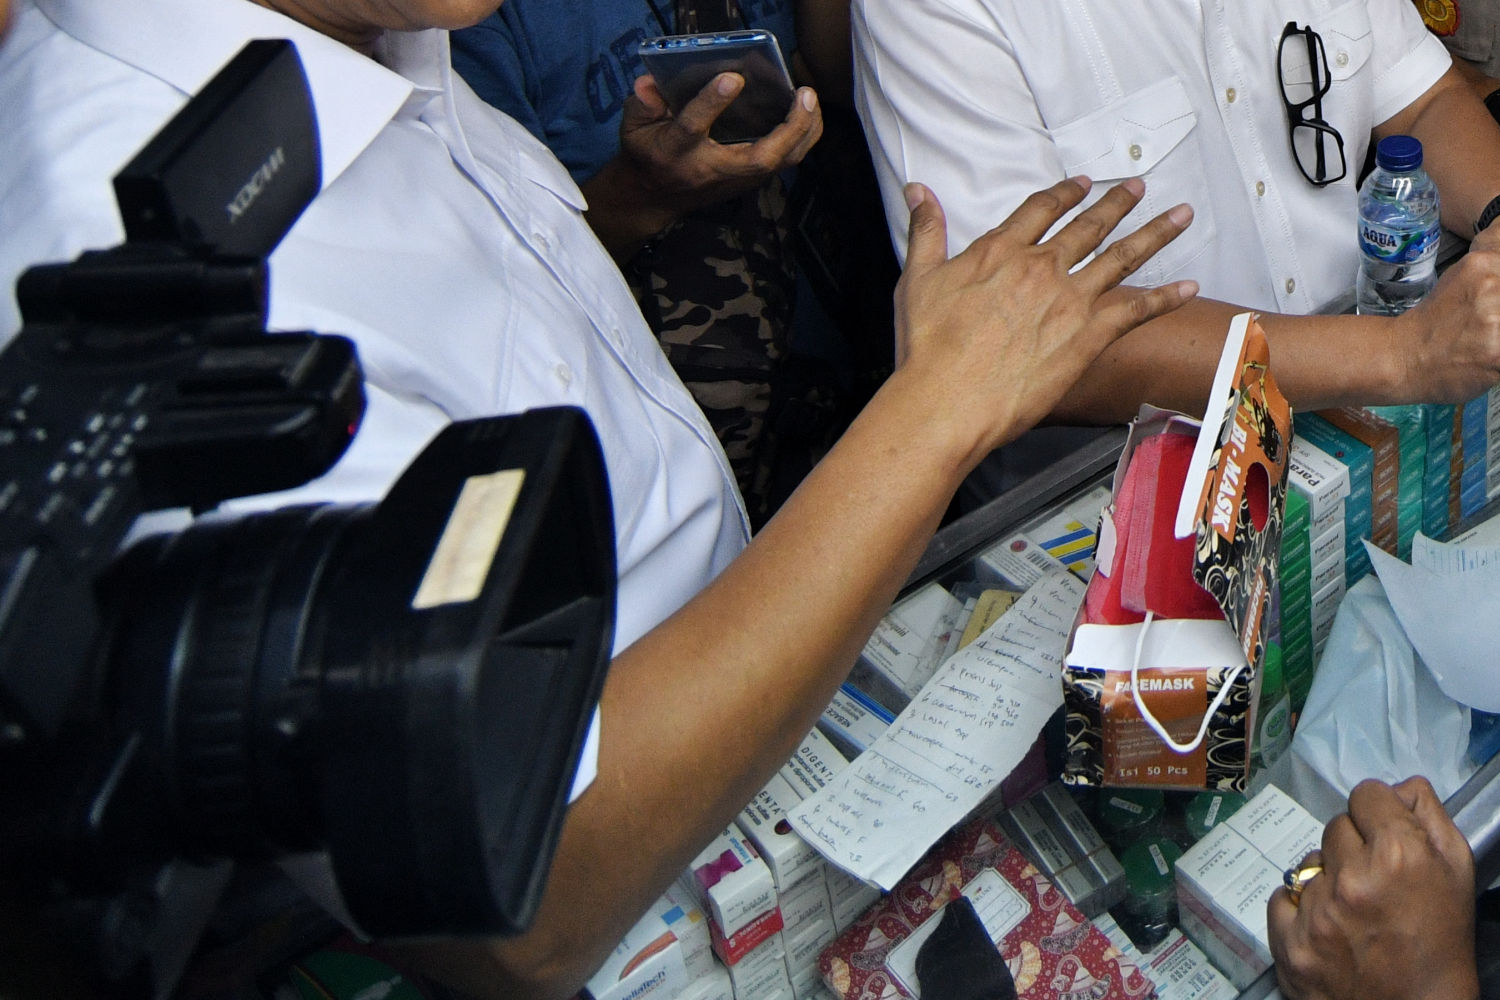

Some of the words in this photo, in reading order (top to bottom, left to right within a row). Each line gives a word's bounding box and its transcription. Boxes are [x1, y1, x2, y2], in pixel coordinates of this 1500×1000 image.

[1363, 226, 1397, 248] AQUA
[1211, 455, 1242, 534] MASK
[1114, 677, 1196, 694] FAEMASK
[824, 707, 853, 729] NEBACE
[1146, 766, 1161, 775] 50
[1167, 765, 1189, 775] Pcs
[758, 789, 782, 816] ENTA
